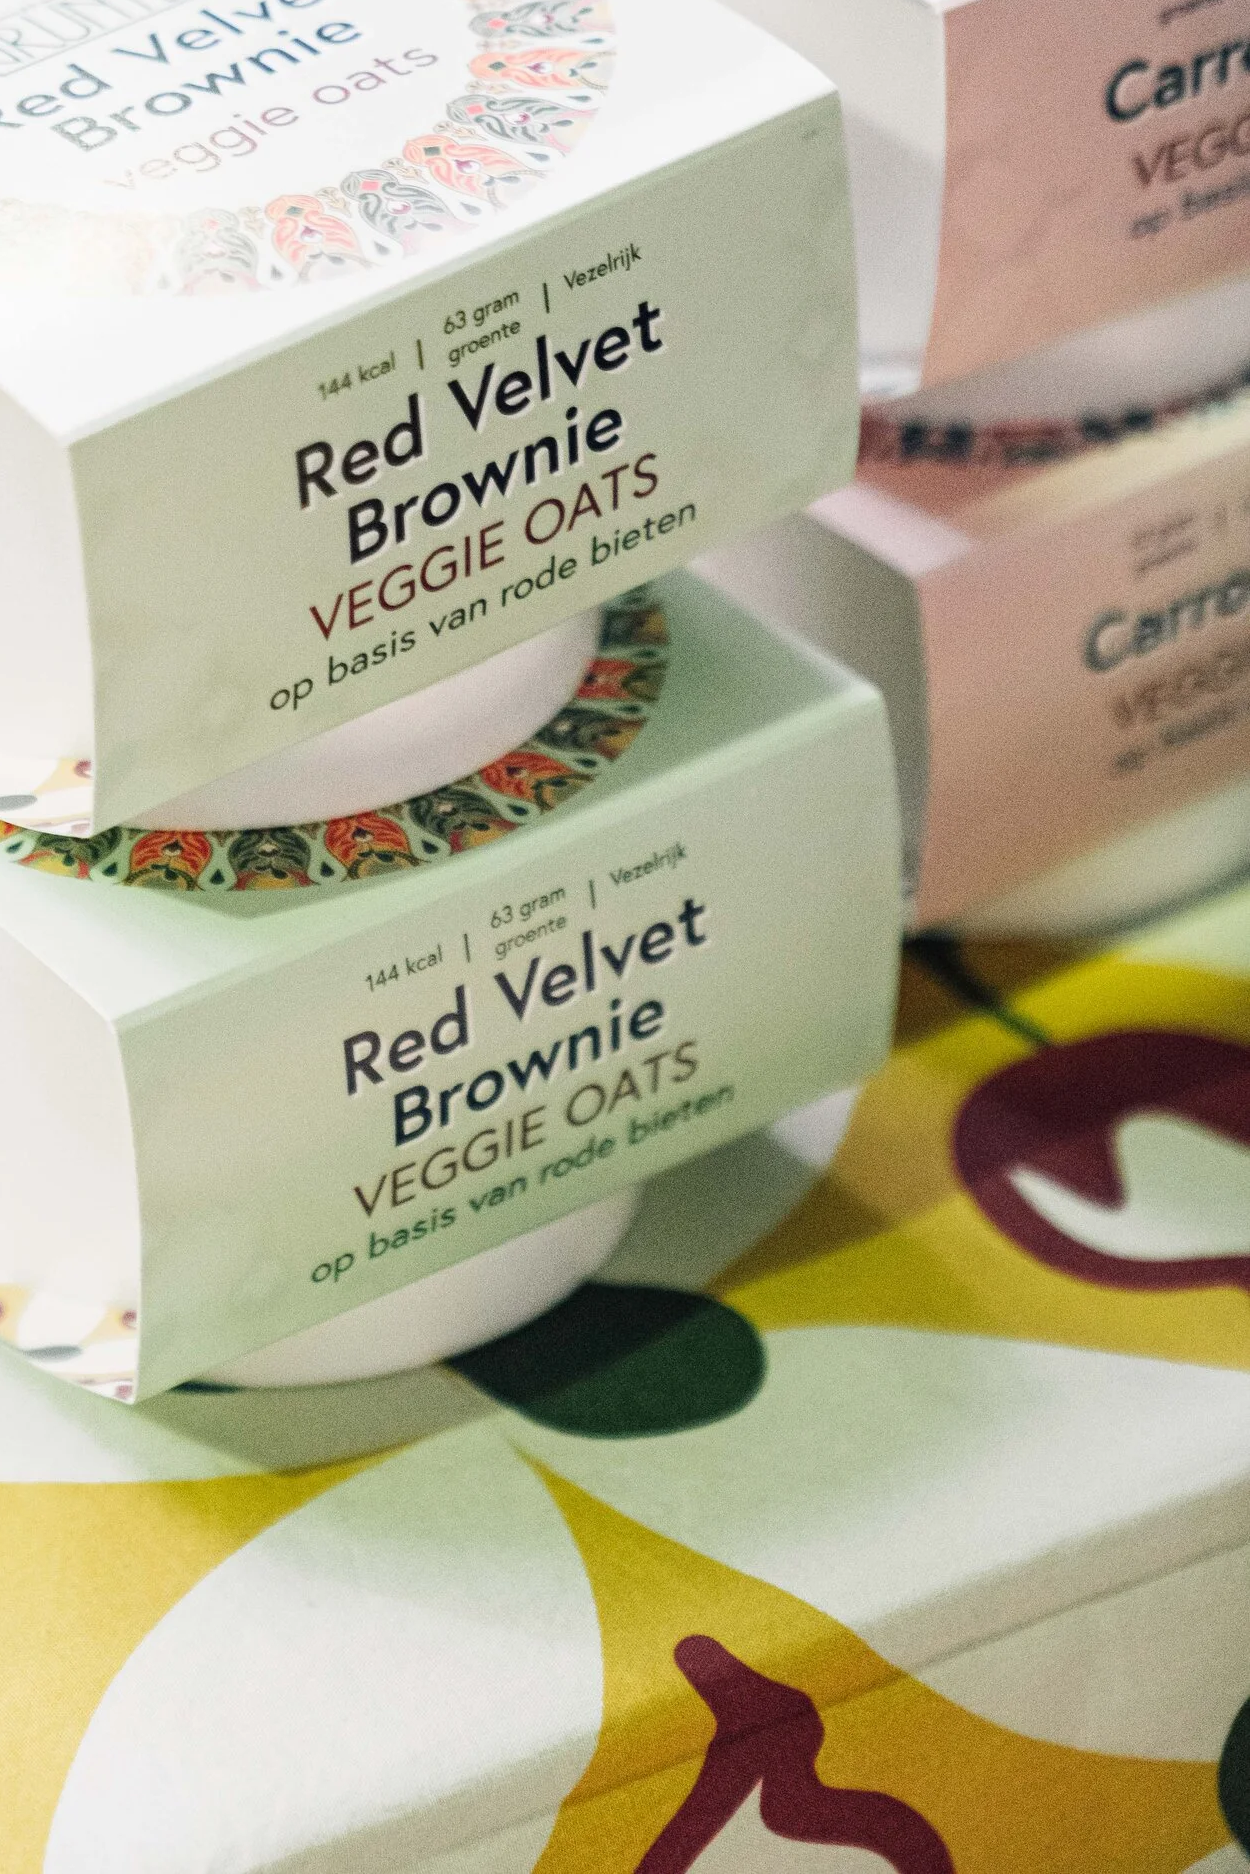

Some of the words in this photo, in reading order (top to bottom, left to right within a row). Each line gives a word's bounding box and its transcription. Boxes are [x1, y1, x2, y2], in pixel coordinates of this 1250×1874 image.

[51, 19, 362, 152] Brownie
[105, 106, 299, 191] veggie
[312, 47, 439, 105] oats
[1106, 38, 1250, 123] Carr
[444, 310, 468, 335] 63
[473, 290, 520, 327] gram
[563, 243, 643, 290] Vezelrijk
[294, 393, 424, 510] Red
[448, 300, 664, 432] Velvet
[317, 370, 352, 401] 144
[358, 350, 396, 384] kcal
[448, 319, 521, 368] groente
[309, 520, 506, 641] VEGGIE
[523, 453, 660, 546] OATS
[347, 406, 623, 565] Brownie
[269, 676, 313, 711] op
[327, 630, 417, 686] basis
[429, 597, 488, 638] van
[500, 554, 577, 608] rode
[590, 501, 697, 566] bieten
[490, 905, 513, 929] 63
[519, 886, 566, 921] gram
[609, 841, 687, 886] Vezelrijk
[343, 984, 469, 1096] Red
[494, 898, 707, 1021] Velvet
[365, 963, 399, 992] 144
[405, 944, 443, 976] kcal
[495, 914, 568, 961] groente
[353, 1105, 547, 1218] VEGGIE
[564, 1040, 698, 1128] OATS
[393, 997, 665, 1147] Brownie
[310, 1253, 355, 1284] op
[368, 1205, 457, 1260] basis
[468, 1171, 528, 1213] van
[538, 1134, 616, 1183] rode
[628, 1082, 736, 1145] bieten
